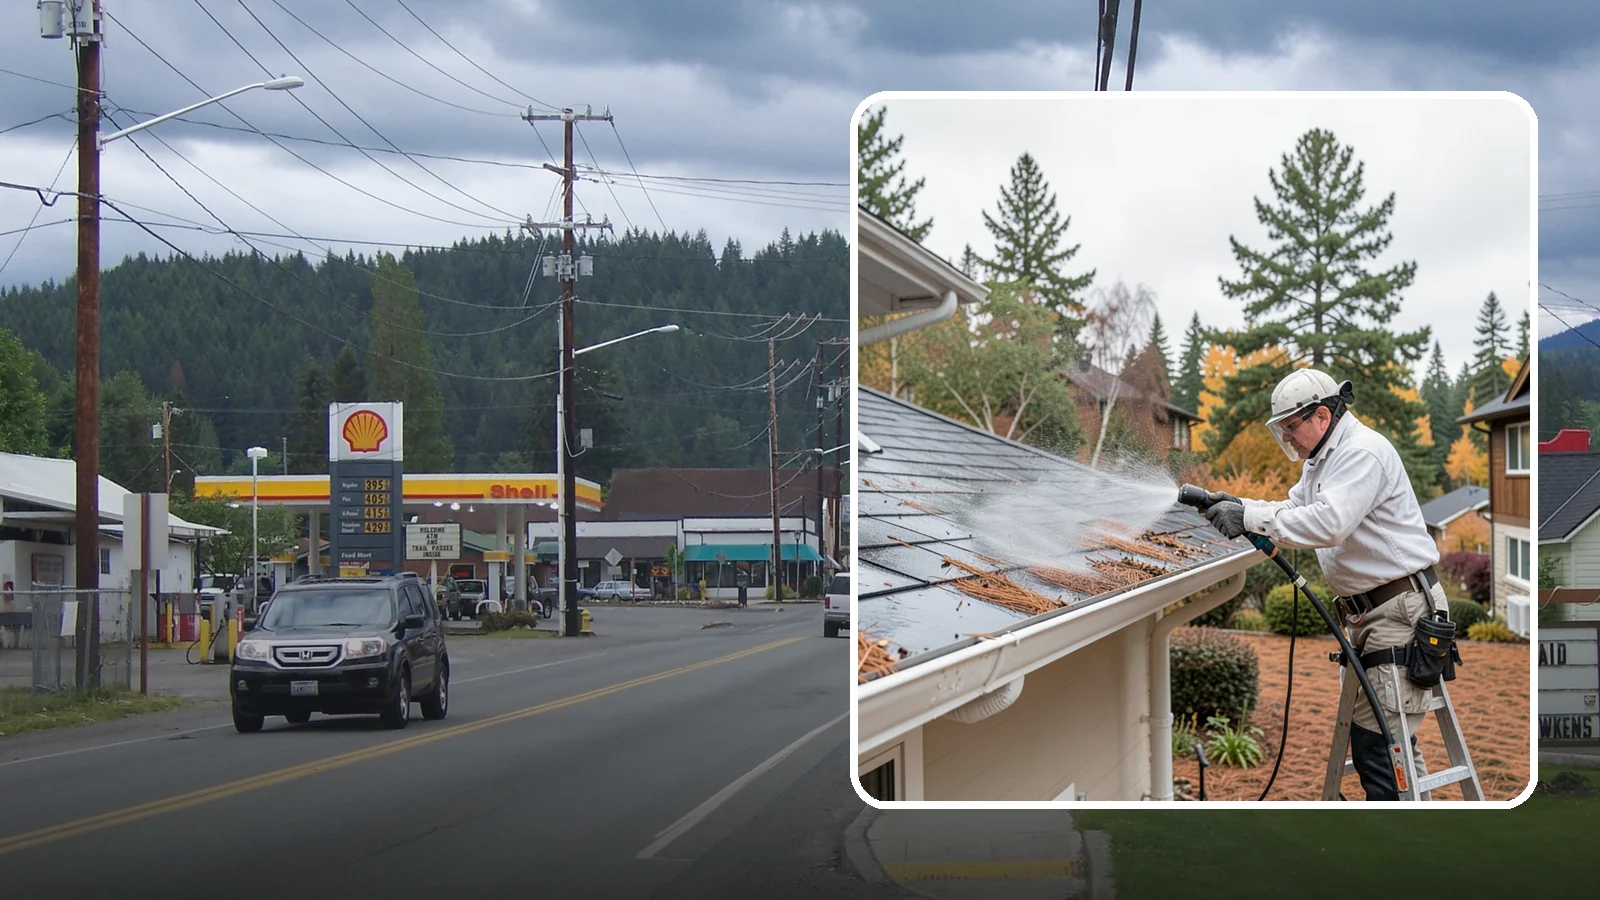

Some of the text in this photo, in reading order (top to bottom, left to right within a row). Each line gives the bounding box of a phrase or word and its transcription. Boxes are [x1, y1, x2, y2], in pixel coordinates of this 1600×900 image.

[365, 480, 383, 490] 395
[490, 484, 547, 498] Shell
[365, 494, 383, 504] 405
[365, 508, 383, 518] 415
[365, 522, 383, 533] 429
[1539, 643, 1566, 665] AID
[1539, 716, 1592, 738] WKENS
